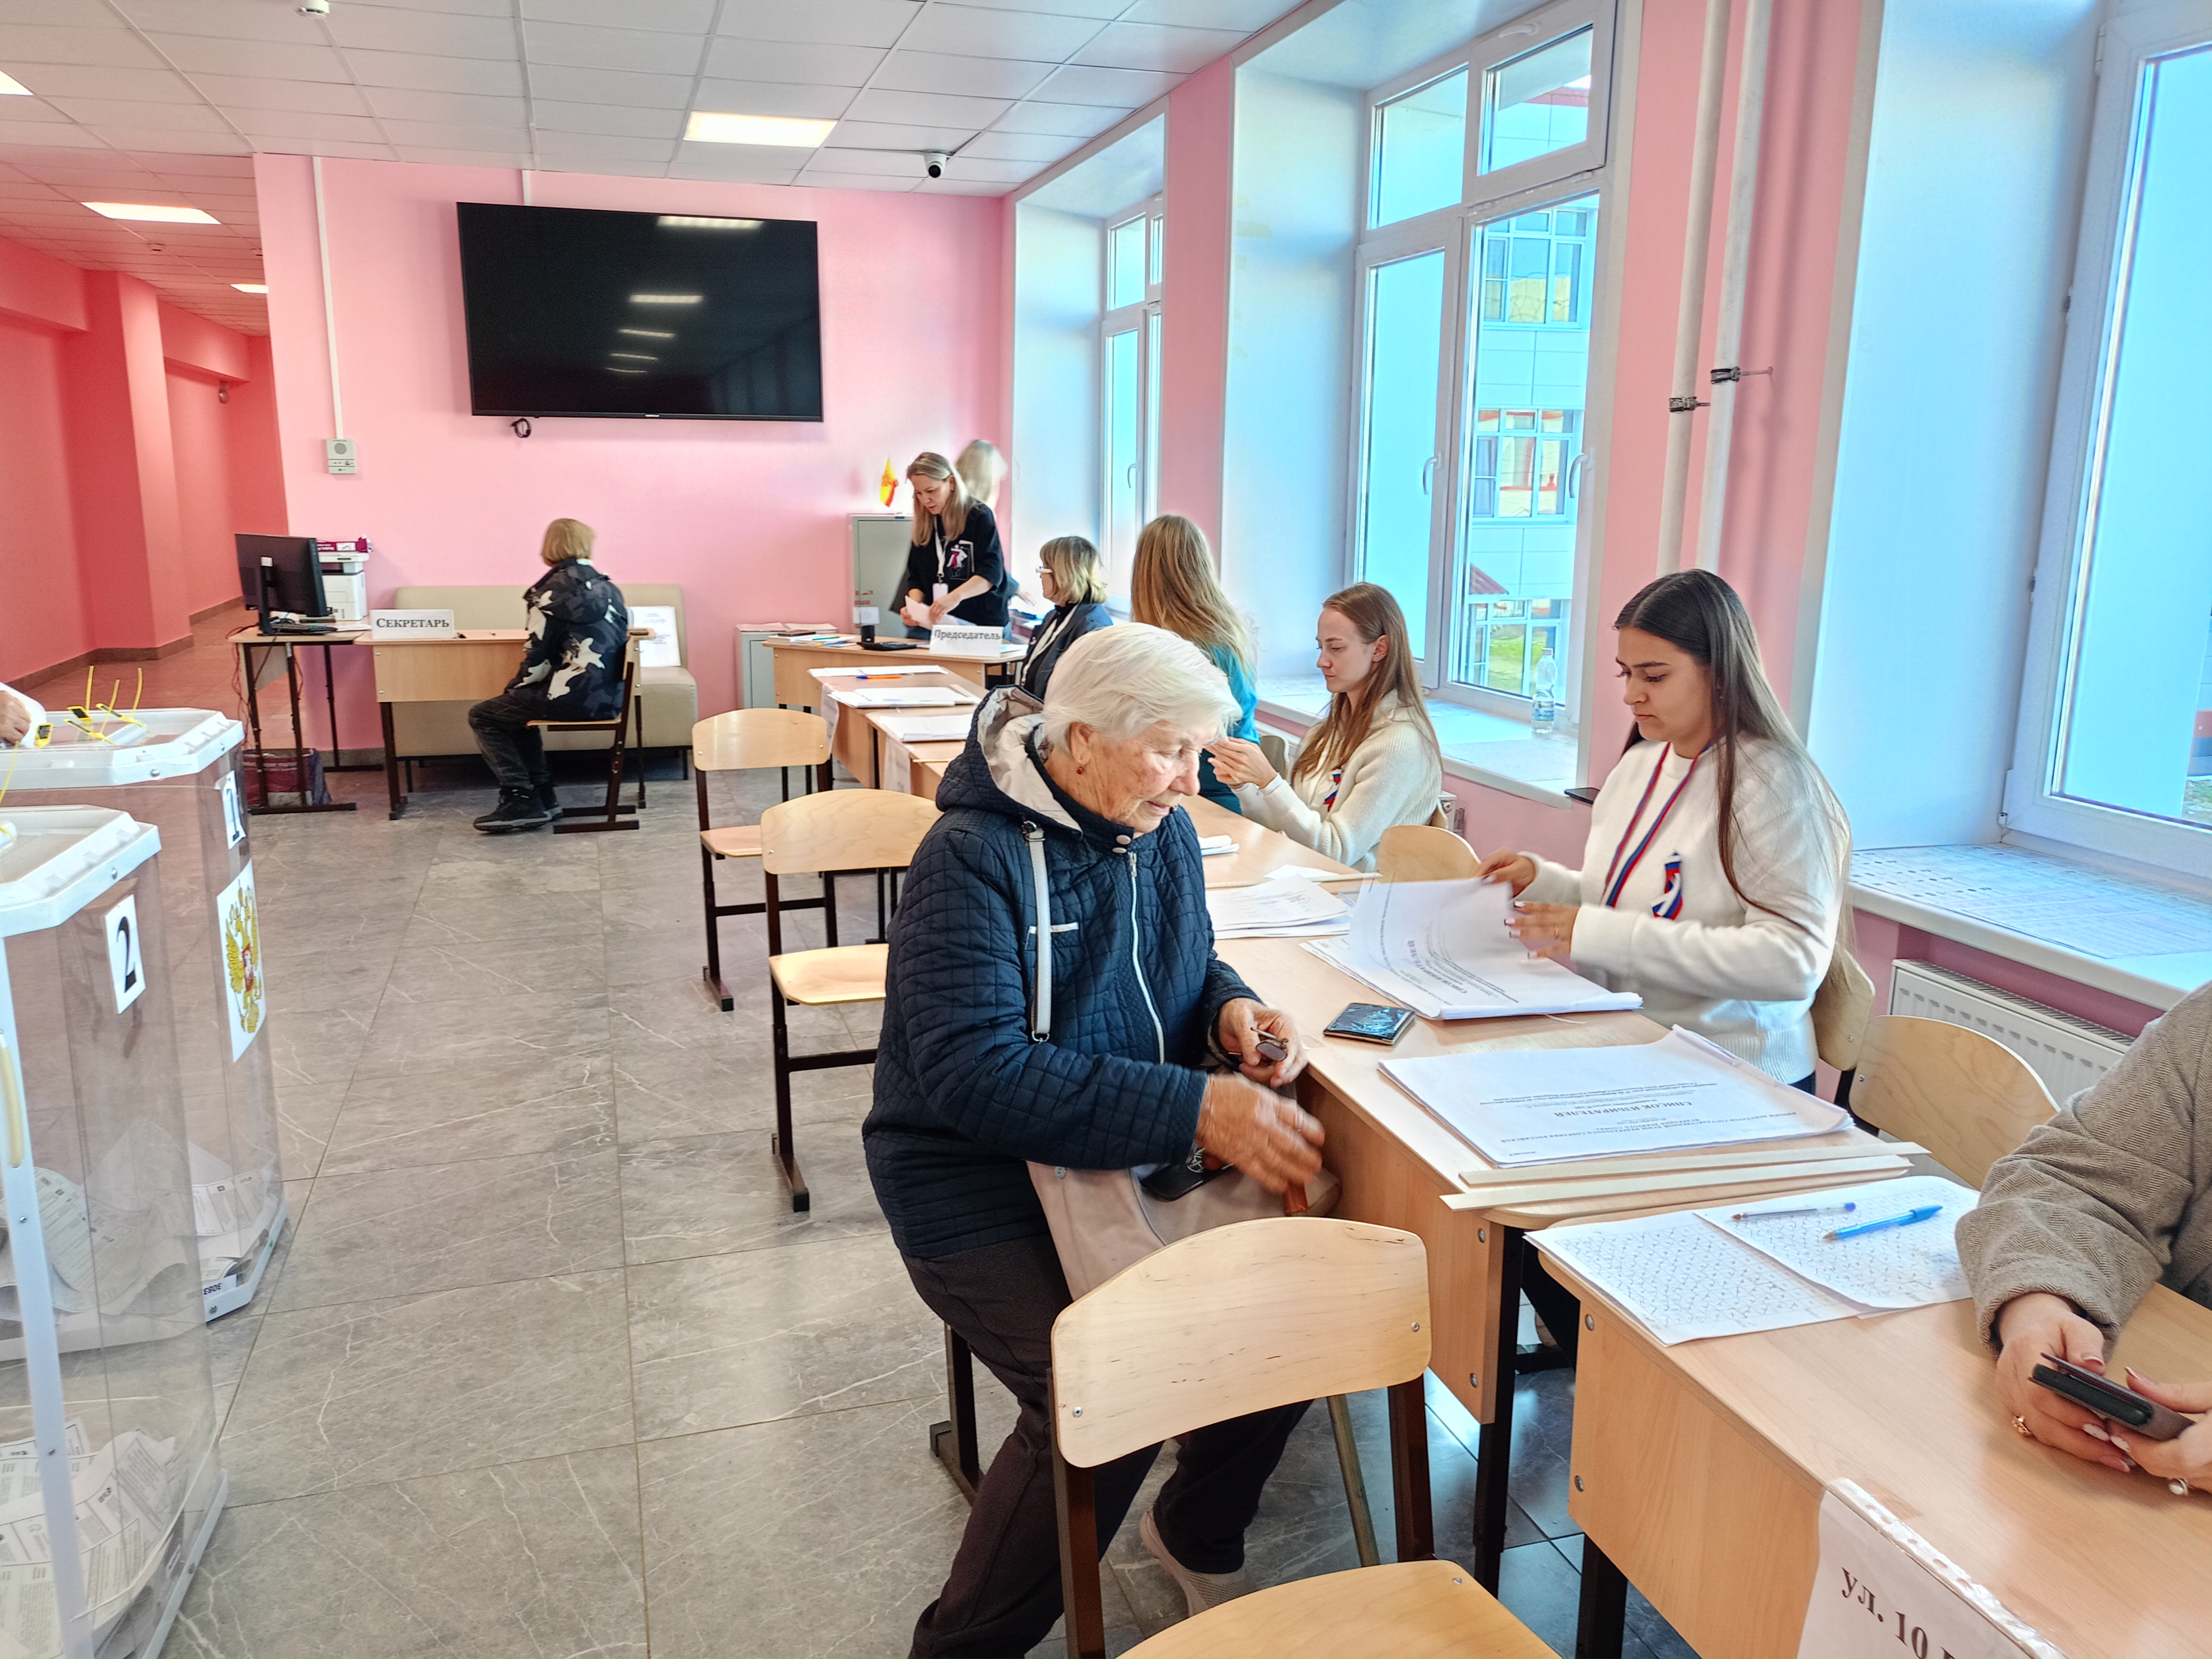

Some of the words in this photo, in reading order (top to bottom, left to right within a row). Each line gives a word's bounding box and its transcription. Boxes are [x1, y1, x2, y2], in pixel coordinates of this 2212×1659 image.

[934, 630, 1001, 640] Председатель
[227, 789, 240, 841] 1
[116, 916, 137, 993] 2
[1554, 1106, 1640, 1117] ИЗБИРАТЕЛЕЙ
[1841, 1567, 1884, 1622] ул.
